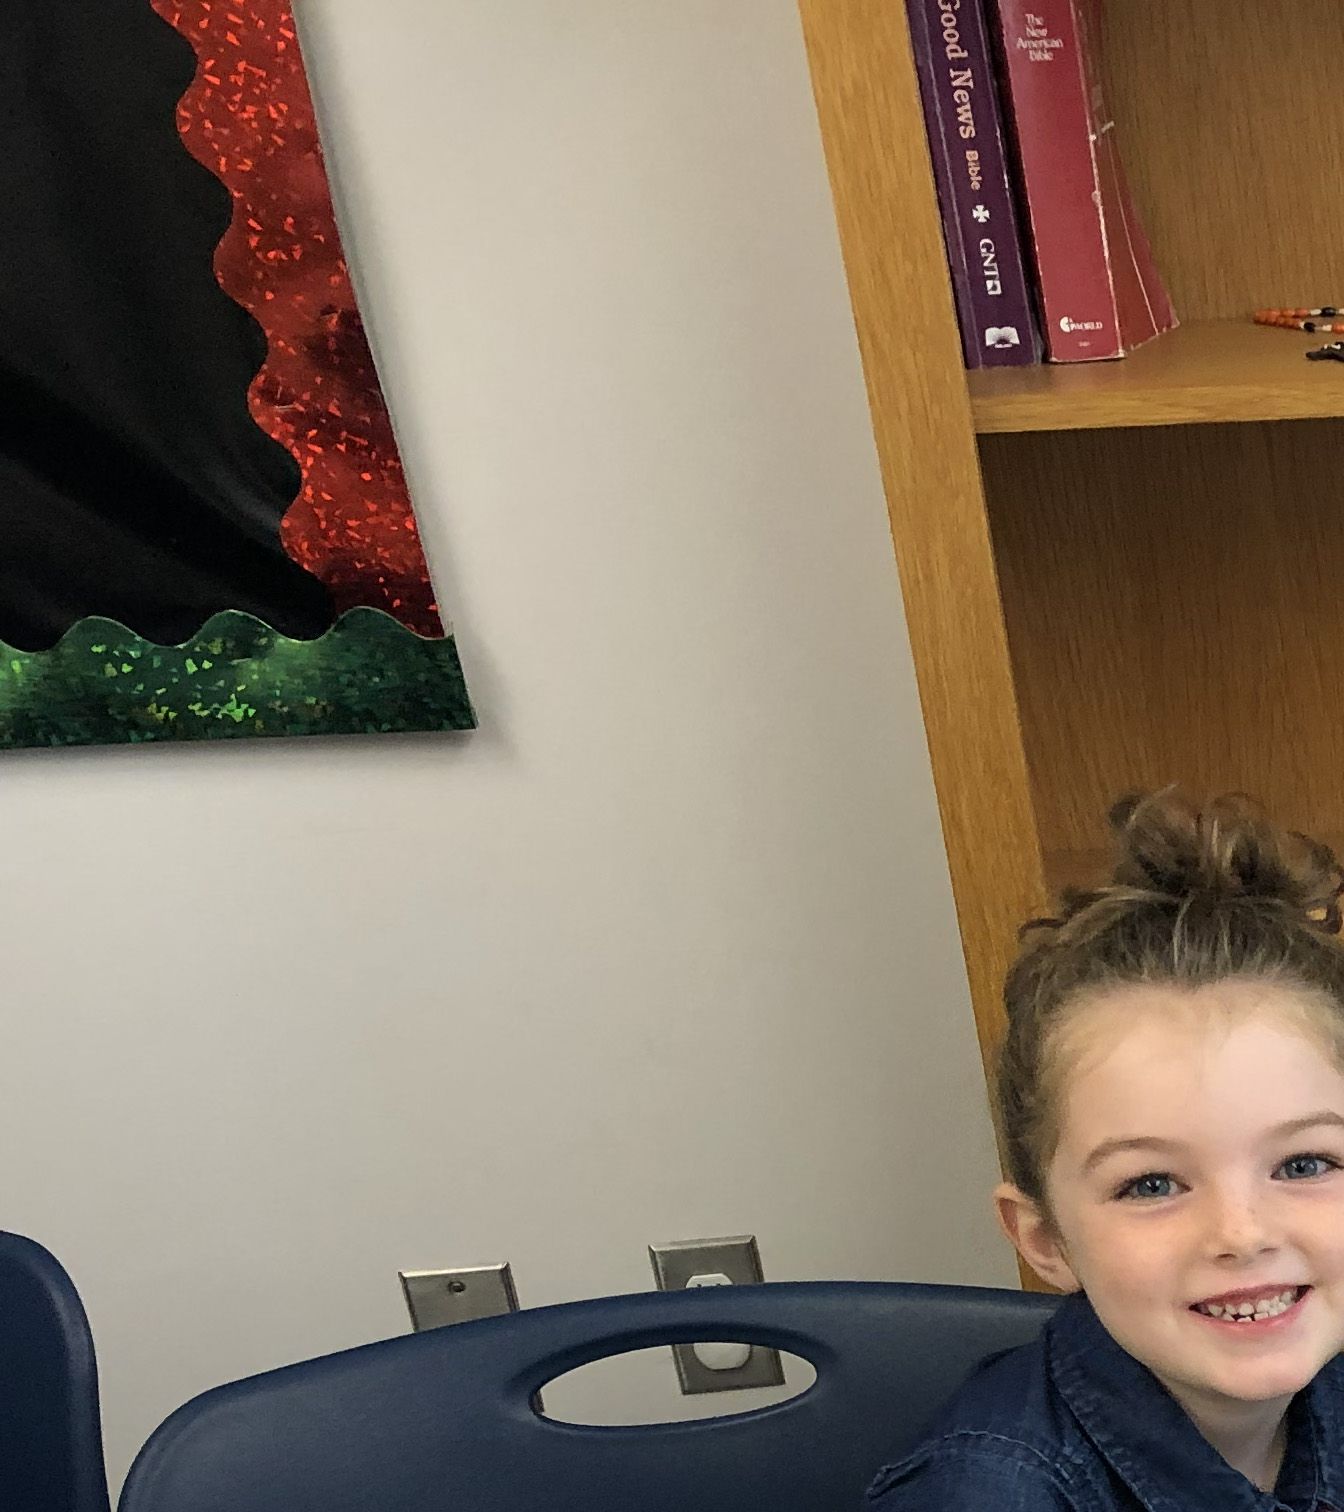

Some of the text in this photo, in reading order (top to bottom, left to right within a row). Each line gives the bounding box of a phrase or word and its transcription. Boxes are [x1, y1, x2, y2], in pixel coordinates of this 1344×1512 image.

[1016, 38, 1064, 49] American
[938, 0, 983, 191] Good News Bible
